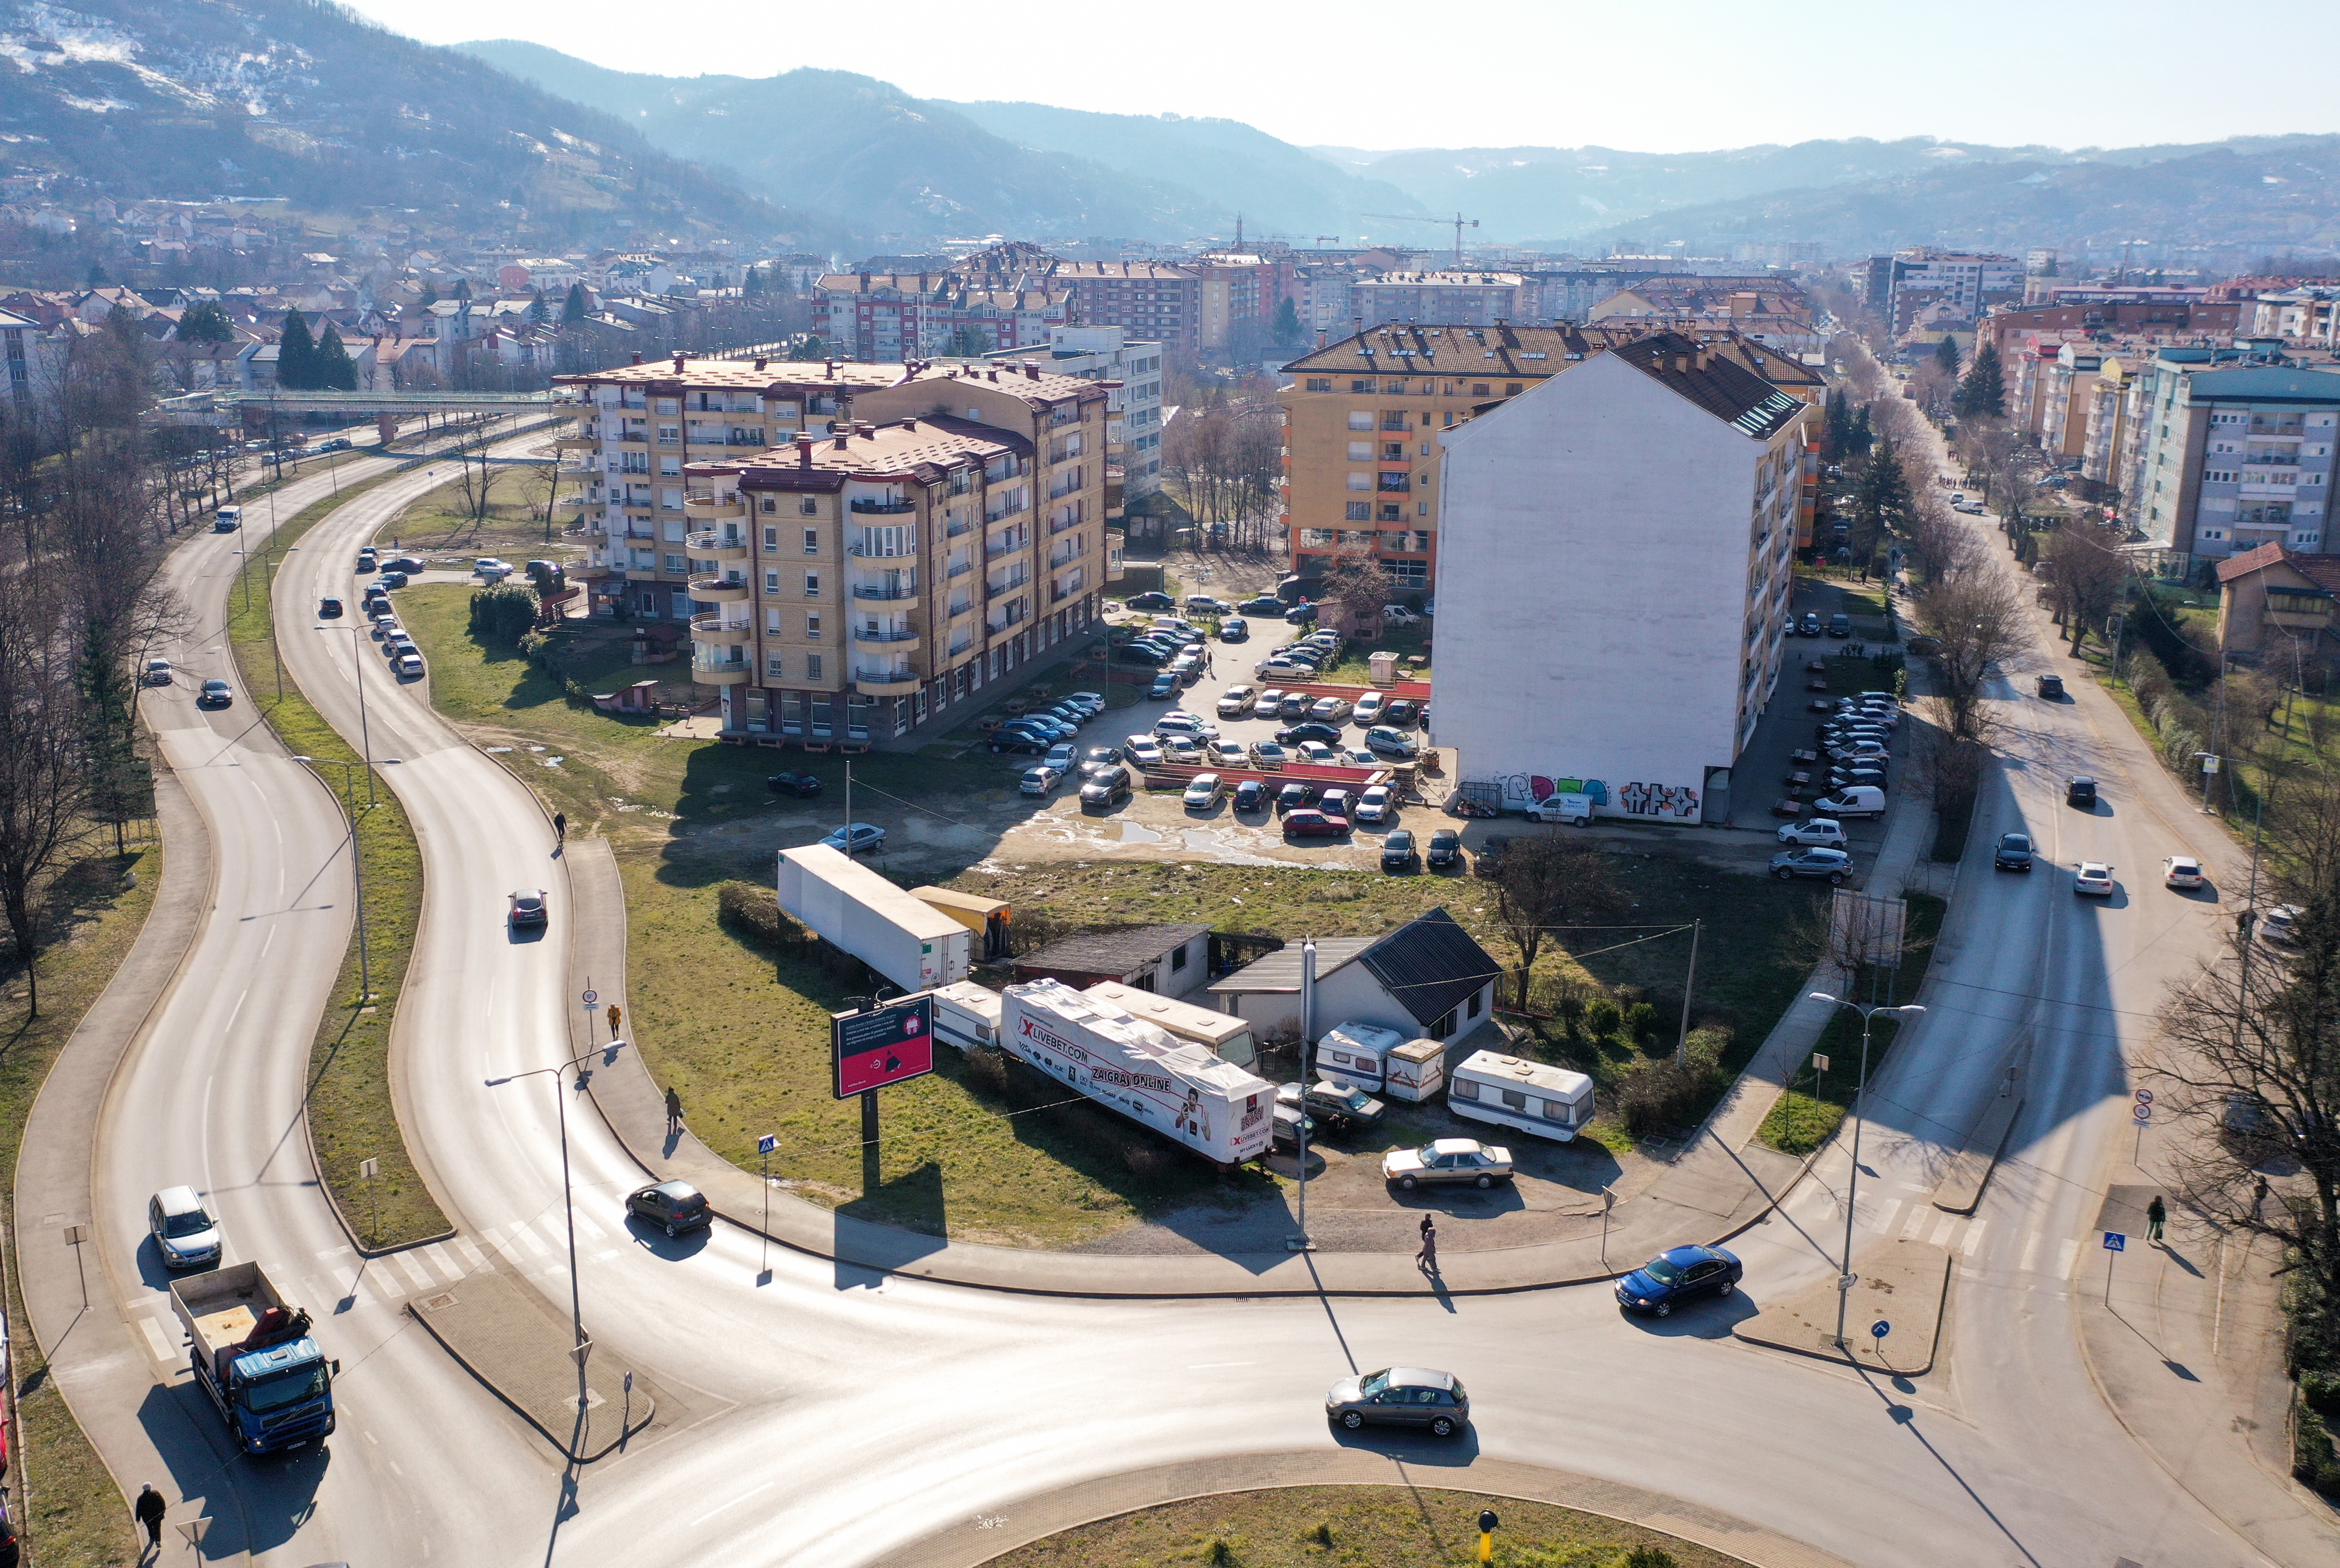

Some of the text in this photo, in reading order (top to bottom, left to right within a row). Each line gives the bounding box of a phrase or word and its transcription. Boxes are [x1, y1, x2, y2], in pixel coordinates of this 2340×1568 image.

[1019, 1041, 1032, 1055] VISA
[1092, 1067, 1170, 1091] ZAIGRAJ ONLINE
[1241, 1114, 1263, 1131] ONLINE
[1246, 1143, 1258, 1151] LUCKY
